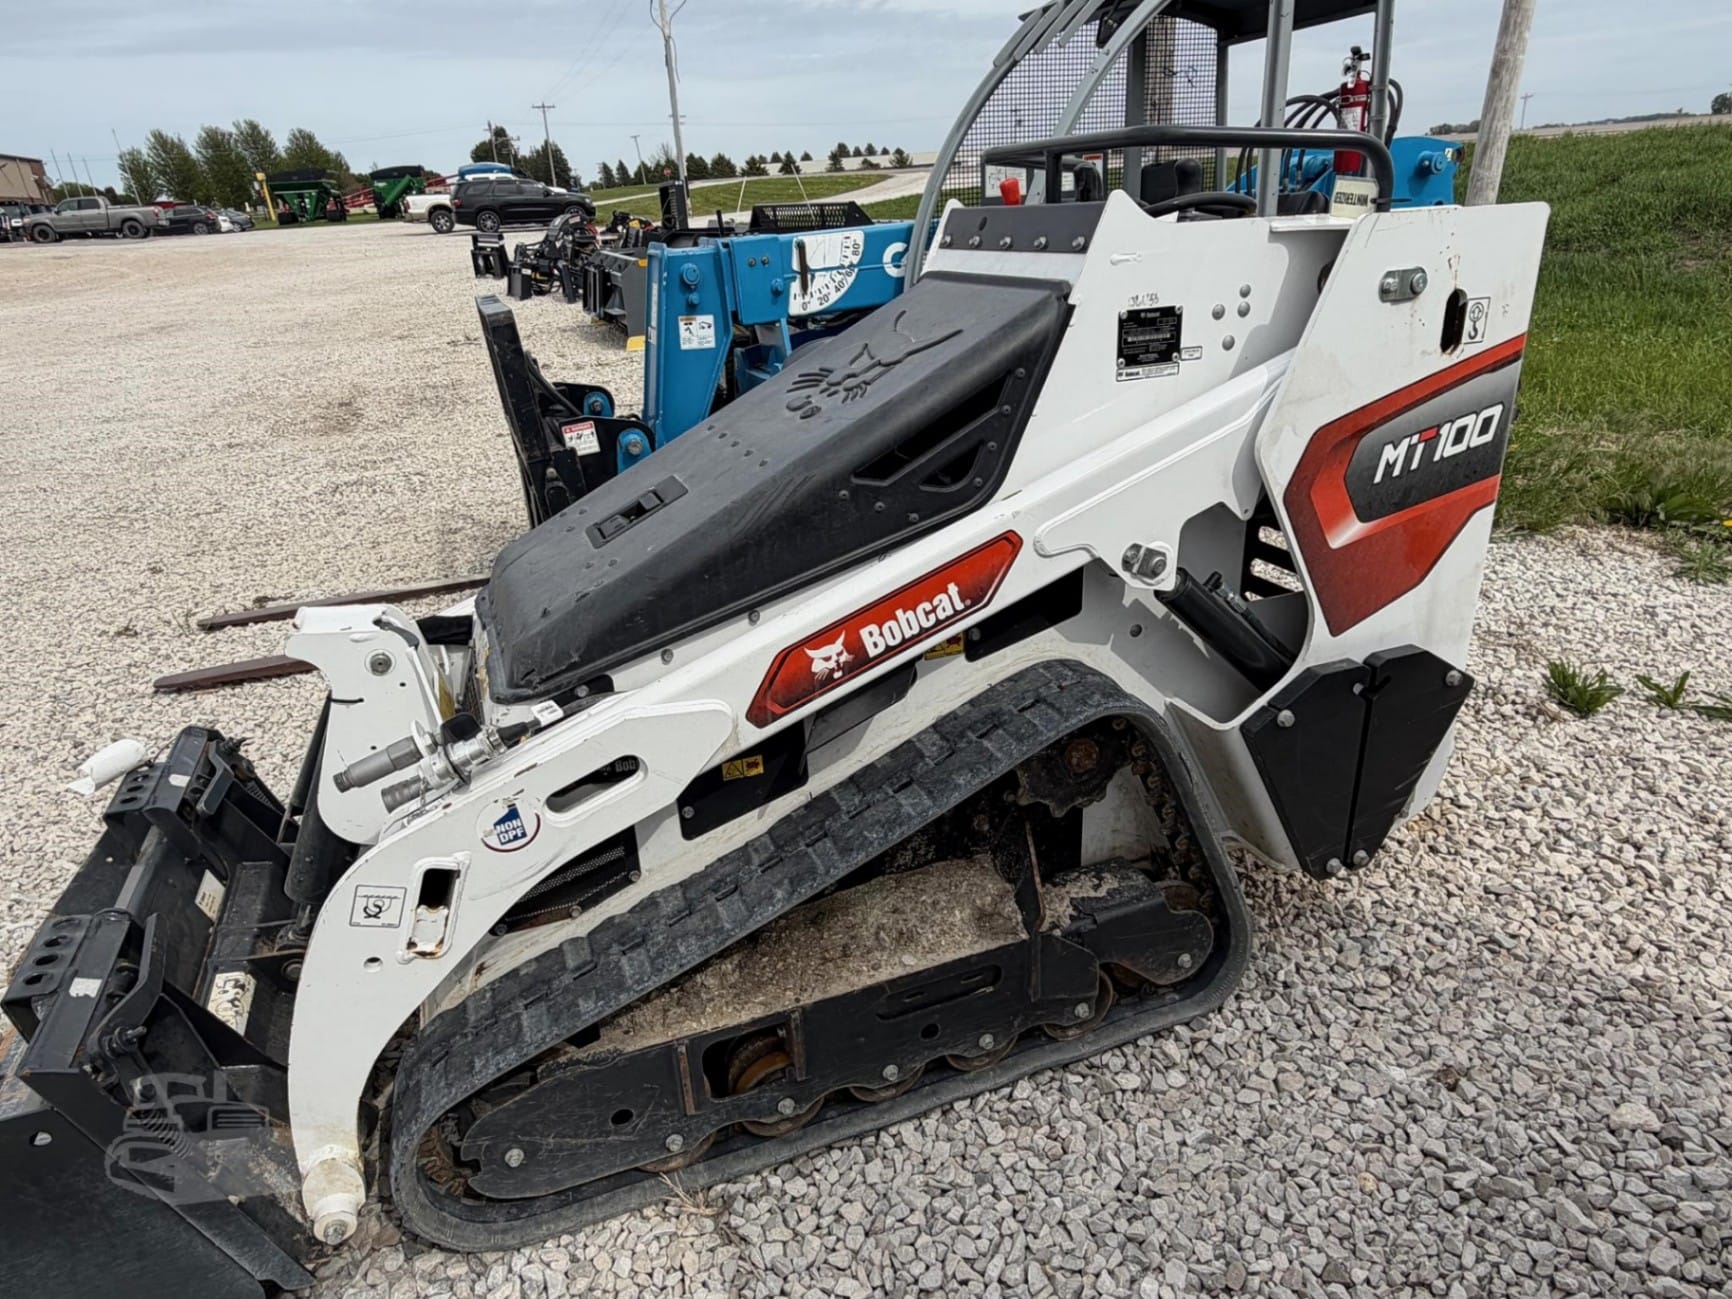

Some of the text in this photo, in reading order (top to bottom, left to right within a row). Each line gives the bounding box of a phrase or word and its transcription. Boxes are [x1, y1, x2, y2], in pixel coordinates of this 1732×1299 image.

[1373, 403, 1504, 485] MT100
[859, 582, 965, 659] Bobcat
[495, 818, 522, 834] NON
[500, 827, 524, 843] DPF
